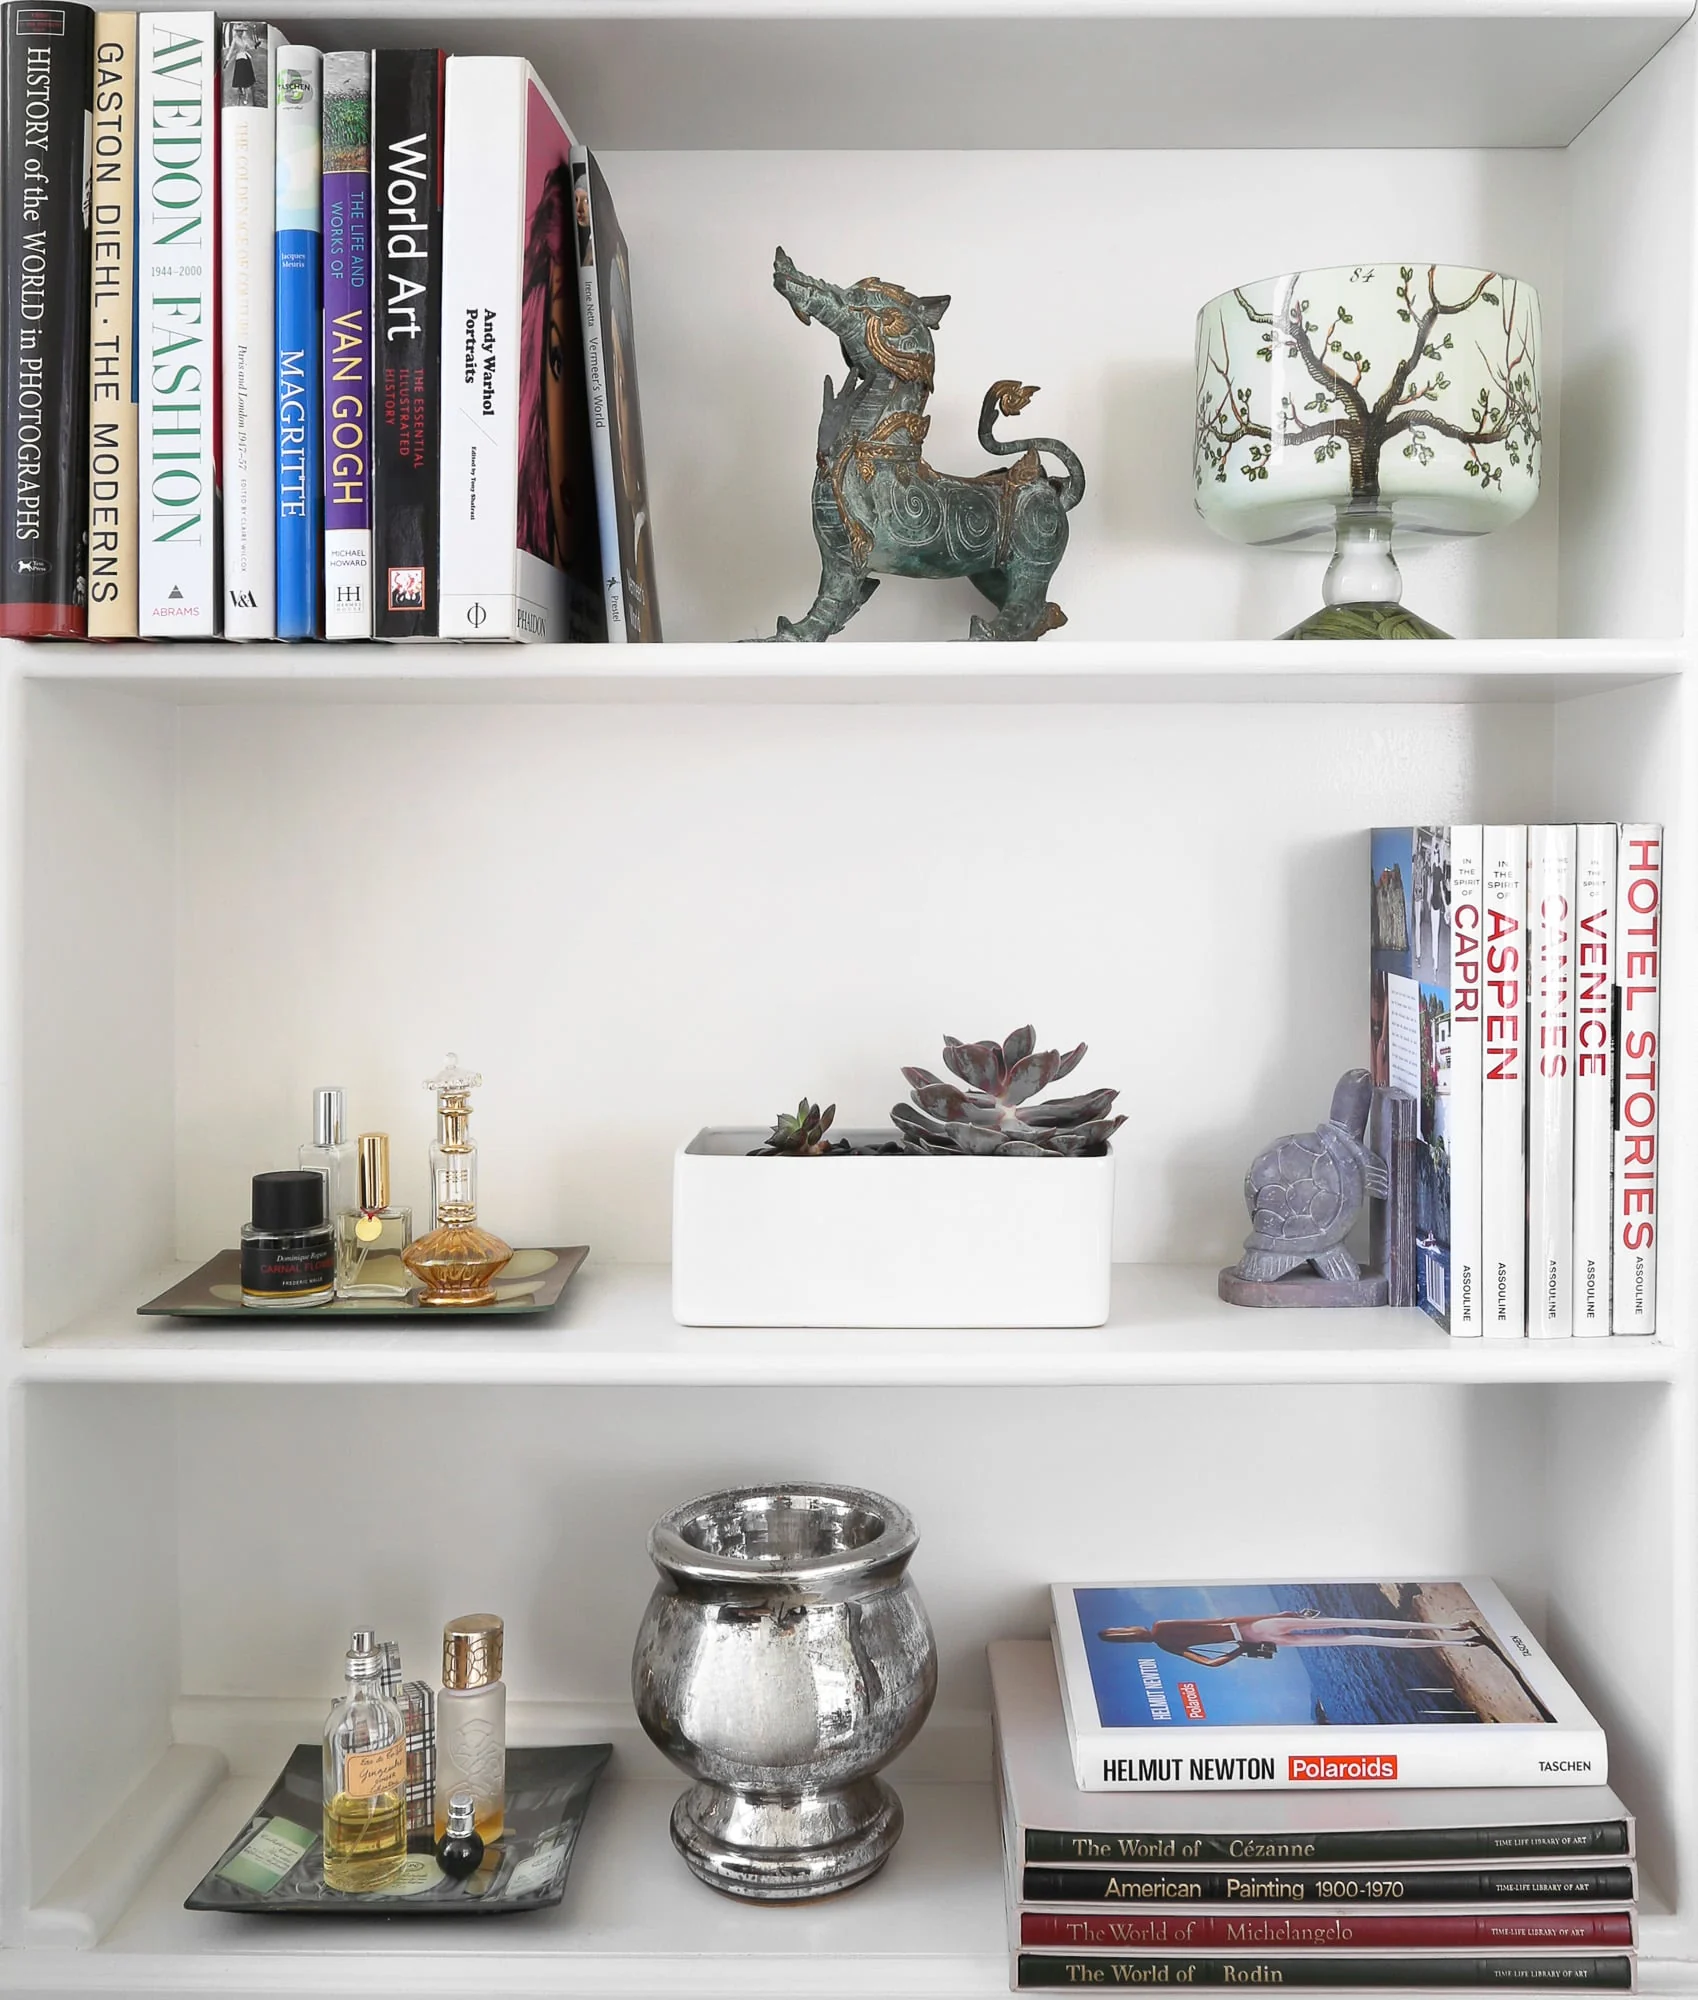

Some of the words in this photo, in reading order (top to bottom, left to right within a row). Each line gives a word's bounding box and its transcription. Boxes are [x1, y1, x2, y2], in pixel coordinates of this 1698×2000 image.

[26, 47, 50, 152] HISTORY
[96, 43, 124, 182] GASTON
[152, 24, 204, 249] AVEDON
[24, 158, 48, 184] of
[23, 187, 48, 221] the
[351, 192, 364, 219] THE
[388, 132, 428, 258] World
[330, 201, 344, 254] WORKS
[351, 226, 364, 252] LIFE
[20, 230, 46, 321] WORLD
[95, 205, 120, 308] DIEHL
[331, 260, 344, 279] OF
[351, 256, 364, 288] AND
[388, 274, 426, 342] Art
[584, 281, 592, 302] Irene
[481, 308, 496, 355] Andy
[586, 304, 594, 327] Netta
[20, 329, 42, 350] in
[332, 310, 362, 380] VAN
[465, 309, 478, 384] Portraits
[94, 335, 120, 402] THE
[238, 372, 248, 390] and
[414, 369, 424, 392] THE
[482, 356, 496, 416] Warhol
[152, 292, 203, 547] FASHION
[238, 392, 248, 428] London
[385, 369, 395, 425] HISTORY
[400, 369, 410, 456] ILLUSTRATED
[594, 395, 606, 428] World
[16, 358, 42, 540] PHOTOGRAPHS
[280, 350, 306, 517] MAGRITTE
[332, 395, 363, 504] GOGH
[414, 398, 424, 468] ESSENTIAL
[470, 468, 476, 476] by
[92, 424, 120, 602] MODERNS
[152, 606, 200, 616] ABRAMS
[230, 590, 258, 608] V&A
[610, 596, 620, 622] Prestel
[1626, 840, 1660, 1011] HOTEL
[1454, 904, 1479, 1022] CAPRI
[1540, 895, 1568, 1078] CANNES
[1486, 908, 1519, 1080] ASPEN
[1578, 908, 1608, 1077] VENICE
[1622, 1030, 1656, 1250] STORIES
[260, 1264, 302, 1274] CARNAL
[1498, 1262, 1506, 1320] ASSOULINE
[1548, 1260, 1557, 1320] ASSOULINE
[1586, 1260, 1595, 1319] ASSOULINE
[1635, 1256, 1644, 1315] ASSOULINE
[1462, 1265, 1471, 1322] ASSOULINE
[1138, 1658, 1163, 1688] NEWTON
[1147, 1690, 1172, 1720] HELMUT
[1180, 1683, 1204, 1720] Polaroids
[1103, 1759, 1183, 1782] HELMUT
[1190, 1758, 1275, 1780] NEWTON
[1292, 1758, 1394, 1779] Polaroids
[1539, 1761, 1592, 1772] TASCHEN
[1072, 1838, 1111, 1857] The
[1117, 1839, 1175, 1857] World
[1182, 1839, 1202, 1858] of
[1229, 1840, 1316, 1858] Cézanne
[1530, 1838, 1560, 1846] LIBRARY
[1572, 1836, 1587, 1844] ART
[1104, 1877, 1202, 1898] American
[1226, 1878, 1305, 1901] Painting
[1315, 1880, 1404, 1898] 1900-1970
[1496, 1884, 1530, 1892] TIME-LIFE
[1066, 1922, 1106, 1941] The
[1108, 1922, 1167, 1941] World
[1174, 1921, 1196, 1940] of
[1226, 1919, 1353, 1944] Michelangelo
[1491, 1928, 1526, 1936] TIME-LIFE
[1528, 1928, 1557, 1936] LIBRARY
[1066, 1964, 1104, 1982] The
[1110, 1964, 1169, 1982] World
[1176, 1964, 1196, 1982] of
[1223, 1965, 1284, 1982] Rodin
[1530, 1970, 1560, 1978] LIBRARY
[1562, 1970, 1572, 1978] OF
[1574, 1970, 1588, 1978] ART
